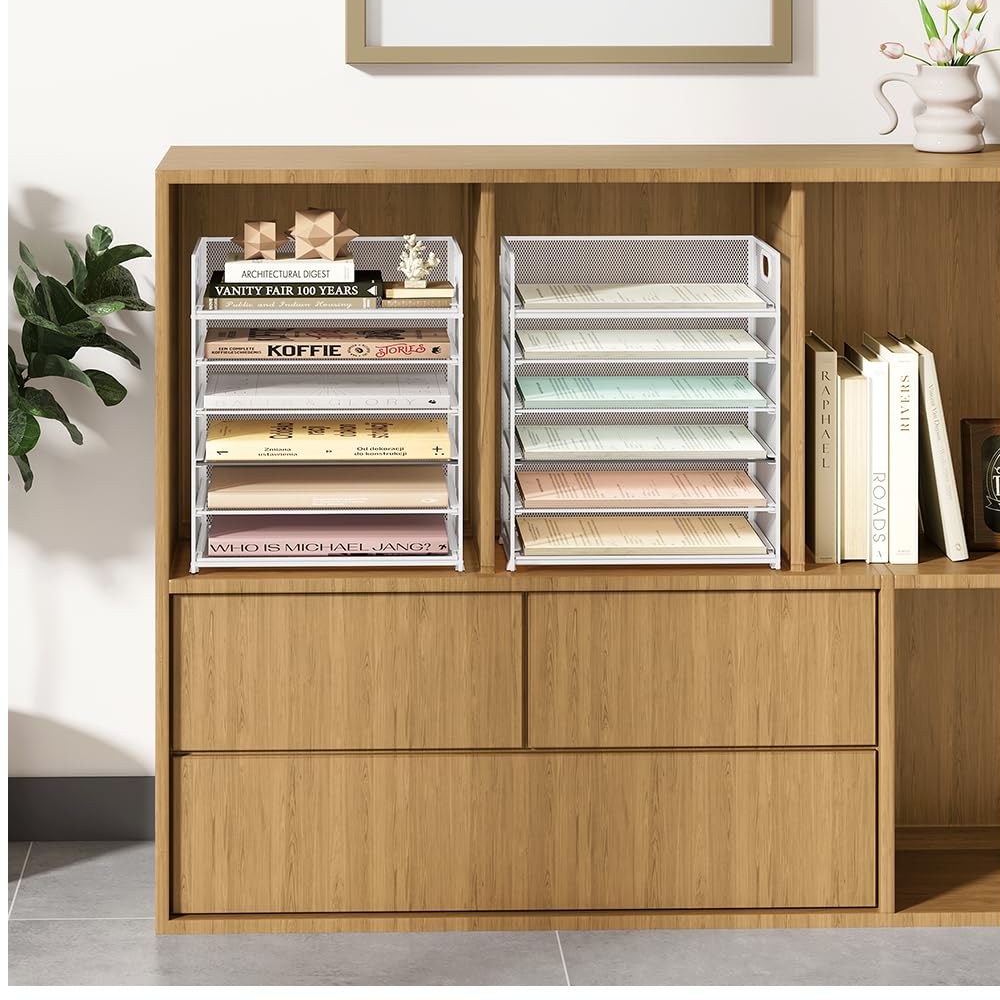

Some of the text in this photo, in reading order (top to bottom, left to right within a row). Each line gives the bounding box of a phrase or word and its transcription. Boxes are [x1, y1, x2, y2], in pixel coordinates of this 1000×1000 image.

[241, 269, 330, 279] ARCHITECTURAL DIGEST
[215, 286, 358, 296] VANITY FAIR 100 YEARS
[268, 344, 342, 357] KOFFIE
[375, 343, 426, 358] STORIES
[900, 375, 910, 432] RIVERS
[820, 370, 831, 468] RAPHAEL
[872, 472, 886, 543] ROADS
[210, 542, 431, 553] WHO IS MICHAEL JANG?
